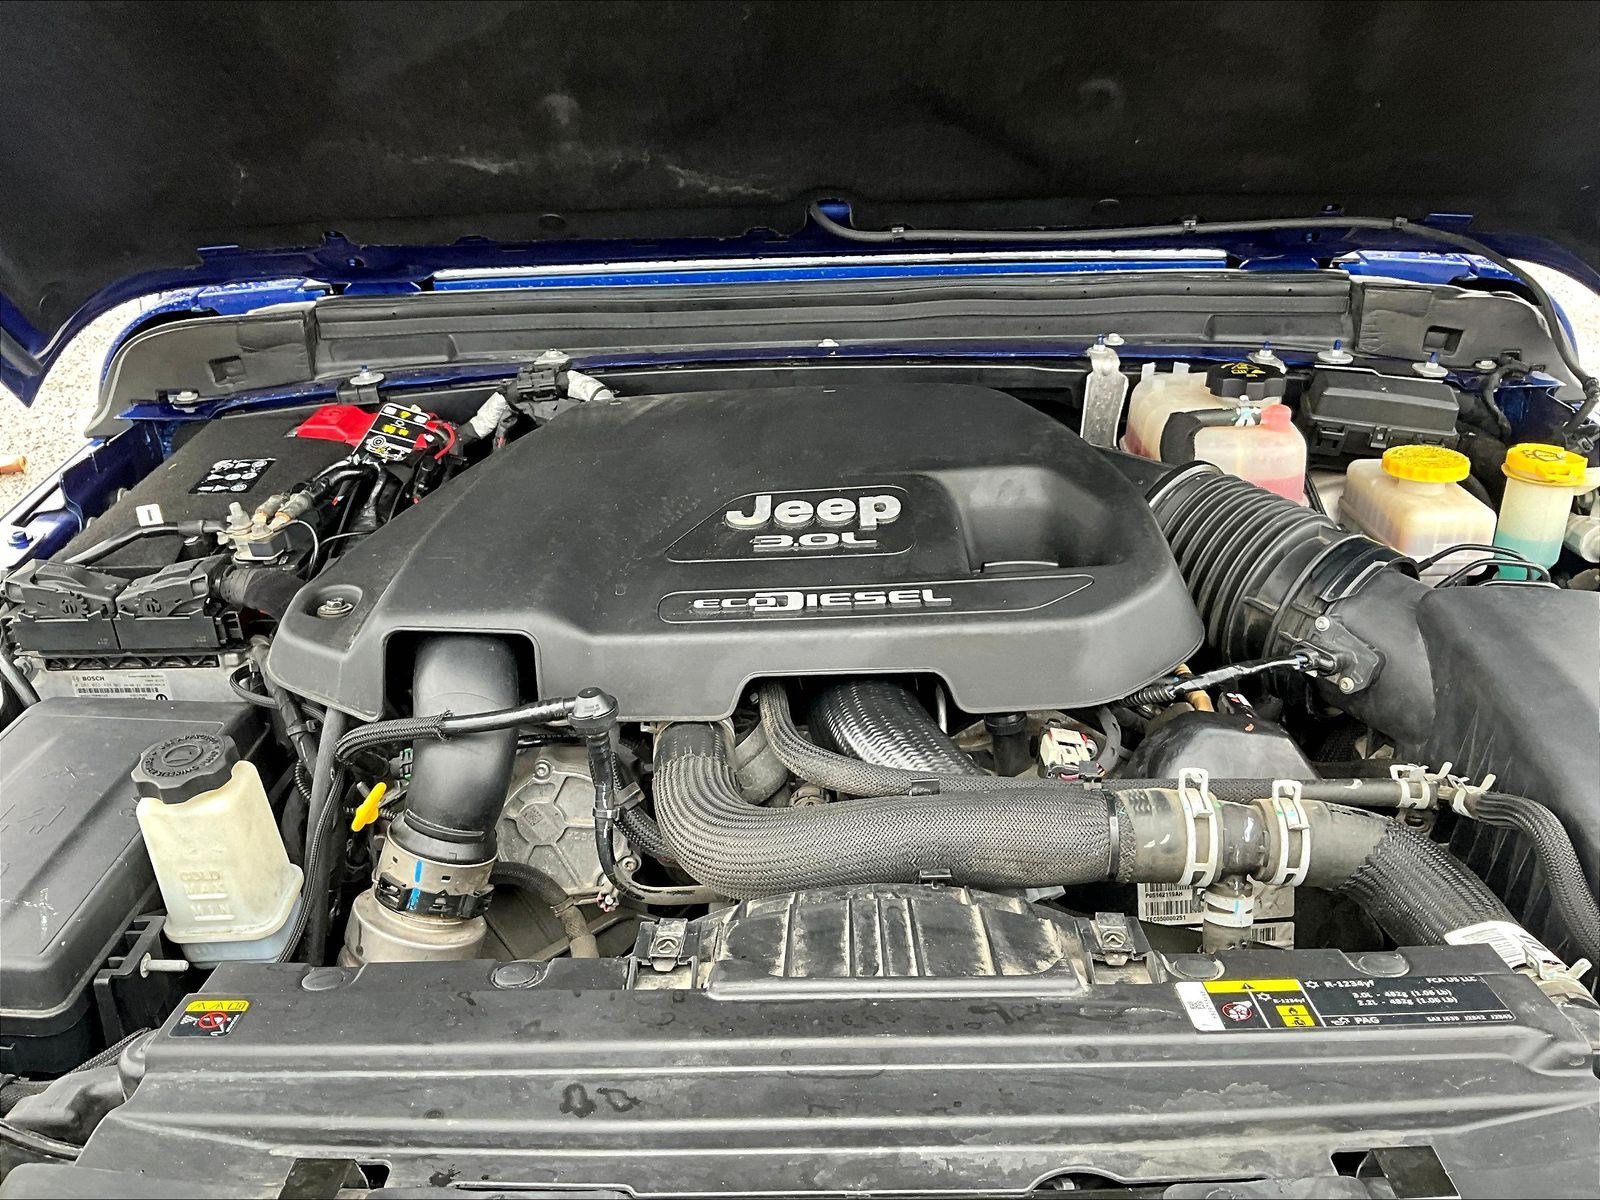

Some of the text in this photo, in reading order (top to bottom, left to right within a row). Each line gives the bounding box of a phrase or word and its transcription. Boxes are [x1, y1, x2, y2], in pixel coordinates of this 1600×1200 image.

[725, 494, 902, 530] Jeep
[751, 531, 878, 551] 3.0L
[180, 871, 221, 881] COLD
[184, 882, 224, 893] MAX
[191, 904, 231, 915] MIN
[1324, 979, 1375, 988] R-1234yf
